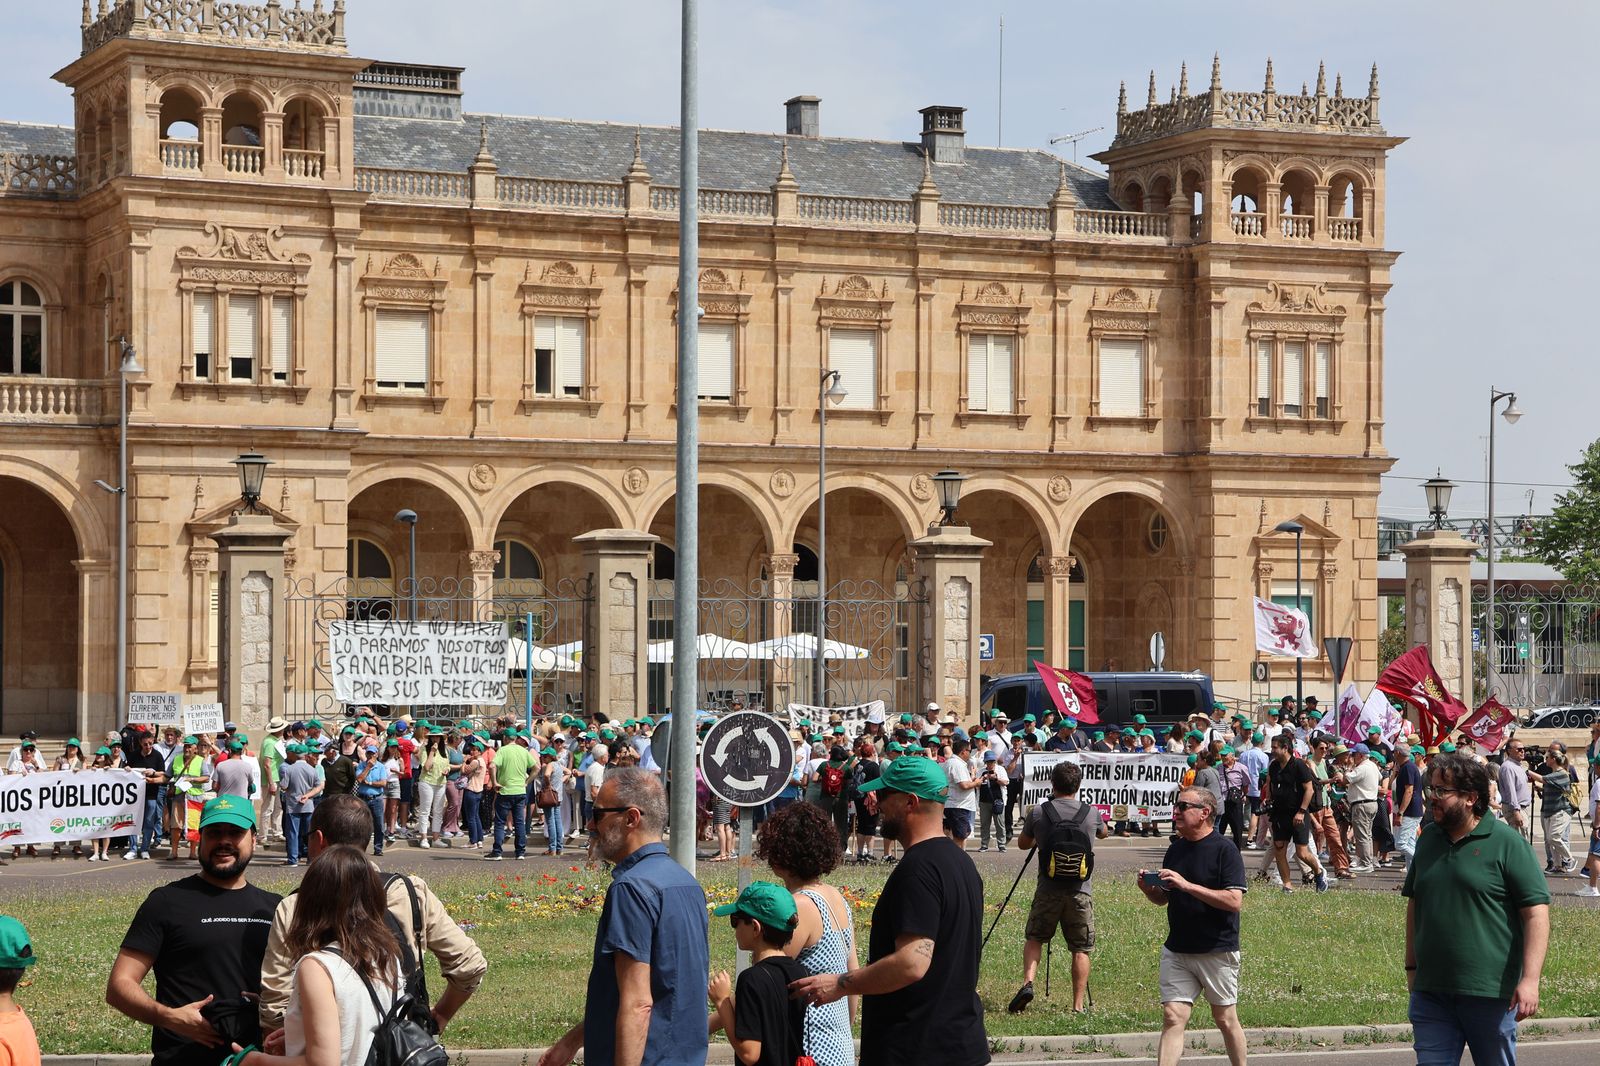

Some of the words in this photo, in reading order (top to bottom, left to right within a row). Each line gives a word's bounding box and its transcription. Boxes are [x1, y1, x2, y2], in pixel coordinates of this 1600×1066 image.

[379, 621, 420, 636] AVE
[428, 621, 449, 636] NO
[453, 622, 503, 637] PARA
[334, 638, 352, 654] LO
[359, 637, 430, 654] PARAMOS
[437, 639, 507, 655] NOSOTROS
[336, 655, 433, 677] SANABRIA
[463, 657, 506, 675] LUCHA
[352, 680, 383, 700] POR
[393, 680, 420, 698] SUS
[431, 680, 507, 700] DERECHOS
[131, 695, 144, 704] SIN
[146, 695, 166, 704] TREN
[168, 695, 177, 705] AL
[163, 704, 177, 712] NOS
[147, 712, 175, 721] EMIGRAR
[187, 711, 221, 719] TEMPRANO
[191, 717, 217, 726] FUTURO
[192, 724, 218, 732] LEJANO
[1080, 763, 1110, 780] TREN
[1113, 764, 1134, 781] SIN
[1137, 765, 1186, 783] PARADA
[39, 780, 138, 810] PÚBLICOS
[1080, 785, 1137, 805] ESTACIÓN
[67, 817, 91, 828] UPA
